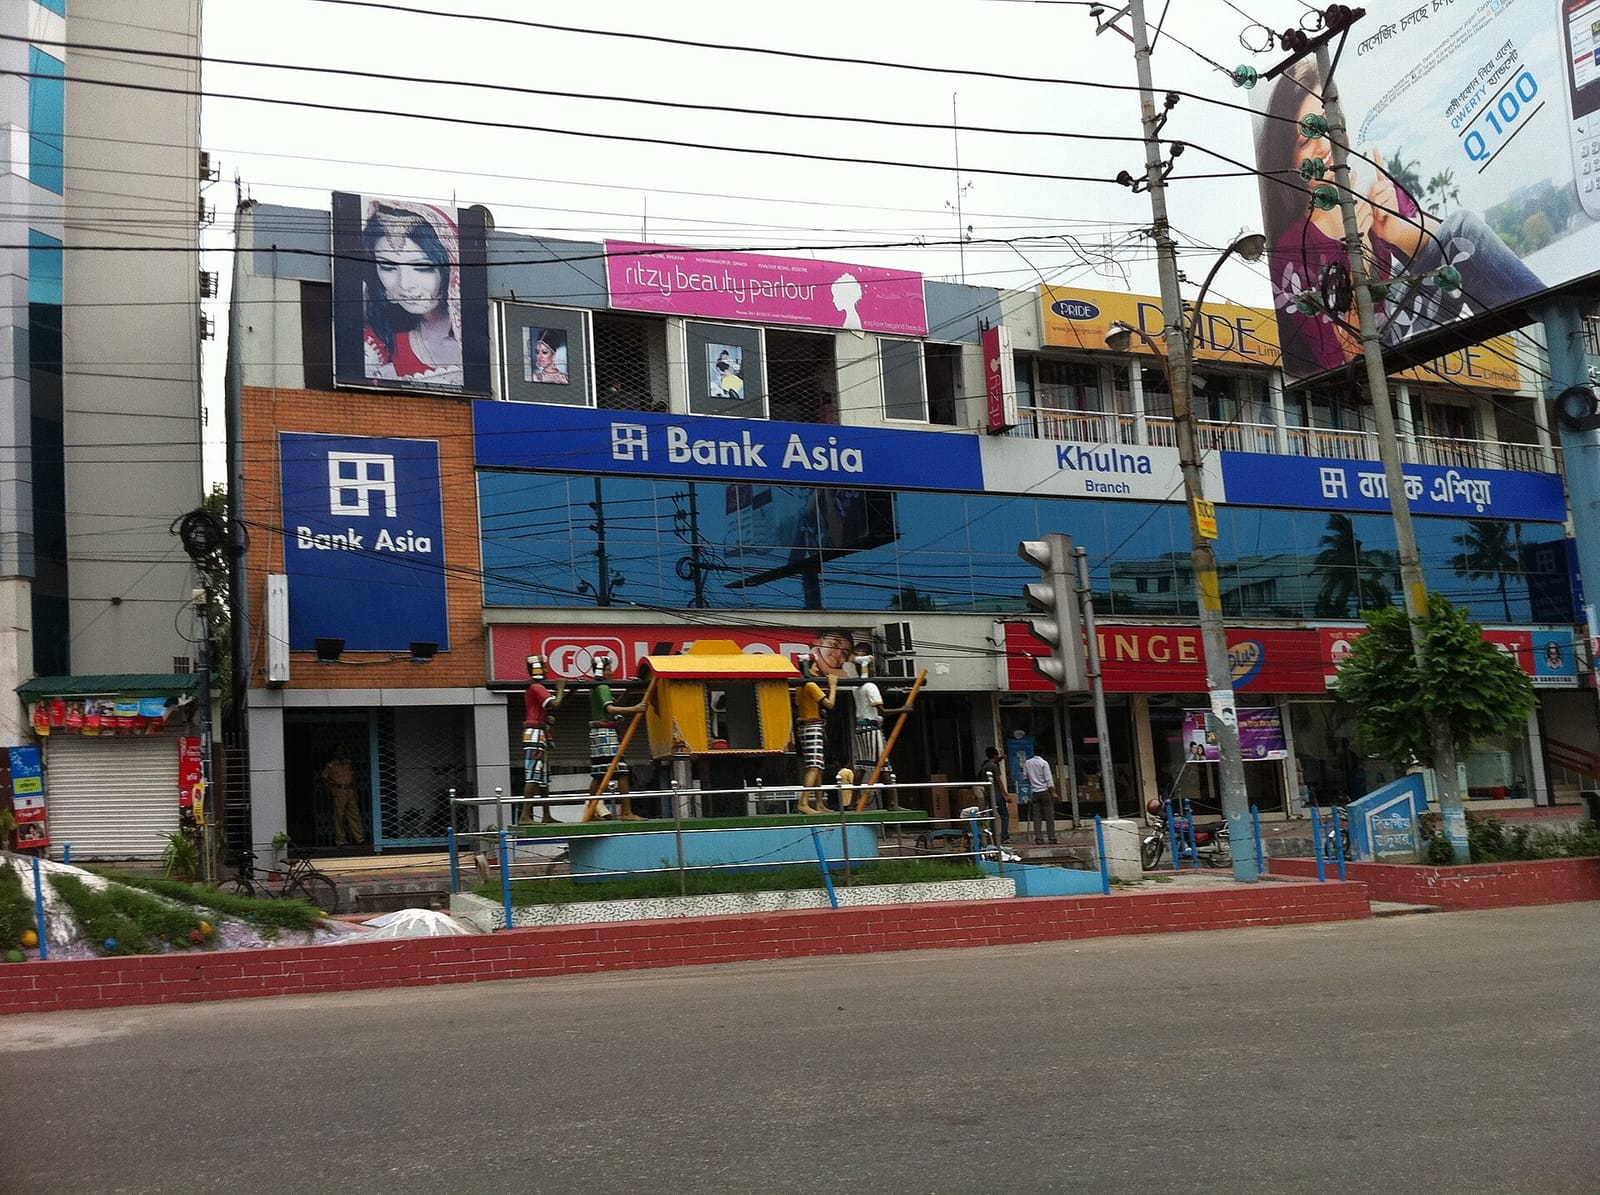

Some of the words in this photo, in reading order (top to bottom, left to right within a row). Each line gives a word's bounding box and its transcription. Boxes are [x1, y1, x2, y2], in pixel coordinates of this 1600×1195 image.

[1357, 24, 1397, 56] মেসেজিং
[1399, 4, 1429, 31] চলছে
[1495, 39, 1514, 60] এলো
[1451, 84, 1487, 129] QWERTY
[1464, 130, 1491, 161] Q
[1485, 72, 1538, 135] 100
[625, 261, 672, 296] ritzy
[675, 264, 746, 303] beauty
[749, 274, 817, 304] parlour
[1059, 303, 1092, 318] PRIDE
[1483, 370, 1517, 382] Limited
[667, 425, 768, 468] Bank
[781, 432, 864, 473] Asia
[1055, 444, 1153, 475] Khulna
[1085, 479, 1131, 494] Branch
[1357, 472, 1424, 501] ব্যাক
[1429, 469, 1492, 513] এশিয়া
[297, 526, 364, 551] Bank
[375, 528, 432, 553] Asia
[1082, 632, 1200, 663] INGE
